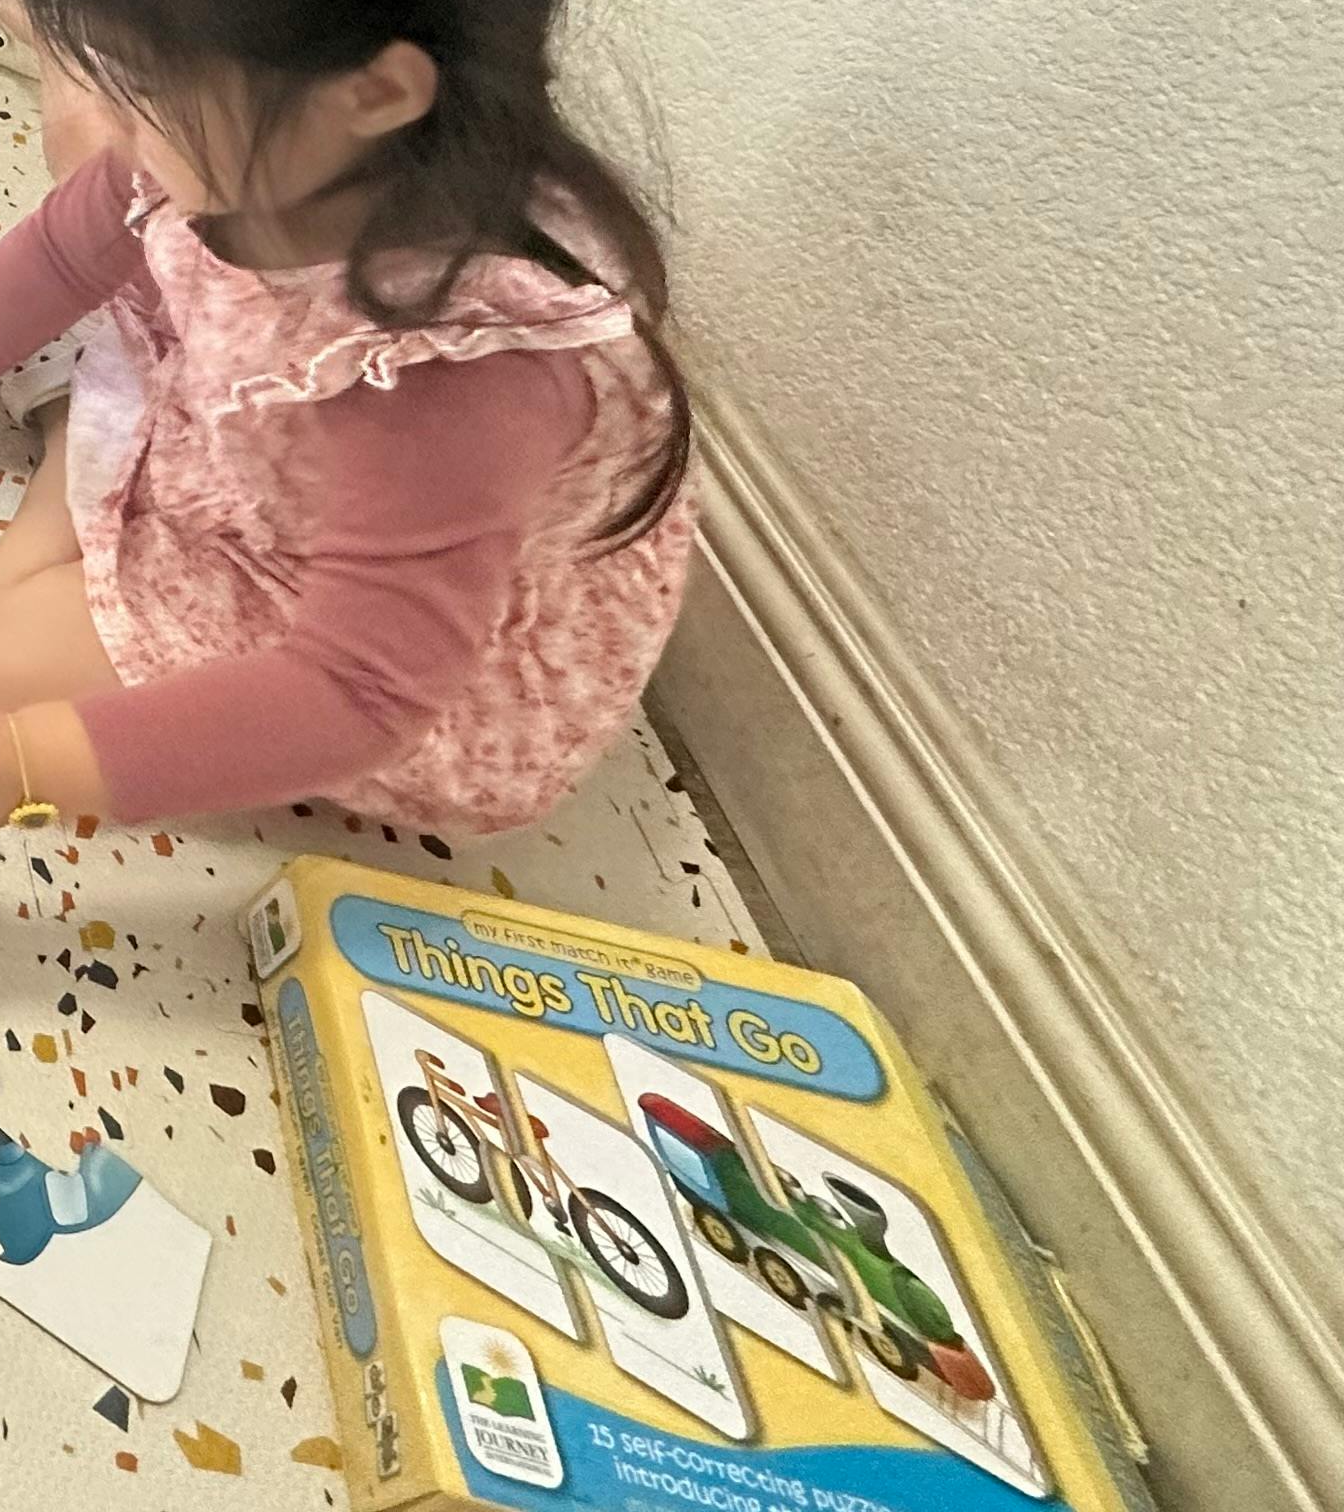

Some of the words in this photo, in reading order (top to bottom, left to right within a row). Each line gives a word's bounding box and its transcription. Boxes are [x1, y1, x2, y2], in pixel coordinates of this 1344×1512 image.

[376, 922, 573, 1018] Things
[577, 970, 718, 1050] That
[727, 1008, 822, 1075] Go
[645, 963, 694, 985] game
[289, 1015, 322, 1137] Things
[316, 1150, 346, 1235] That
[338, 1248, 359, 1316] Go
[474, 1427, 549, 1464] JOURNEY
[587, 1423, 616, 1450] 15
[619, 1432, 809, 1506] self-correcting
